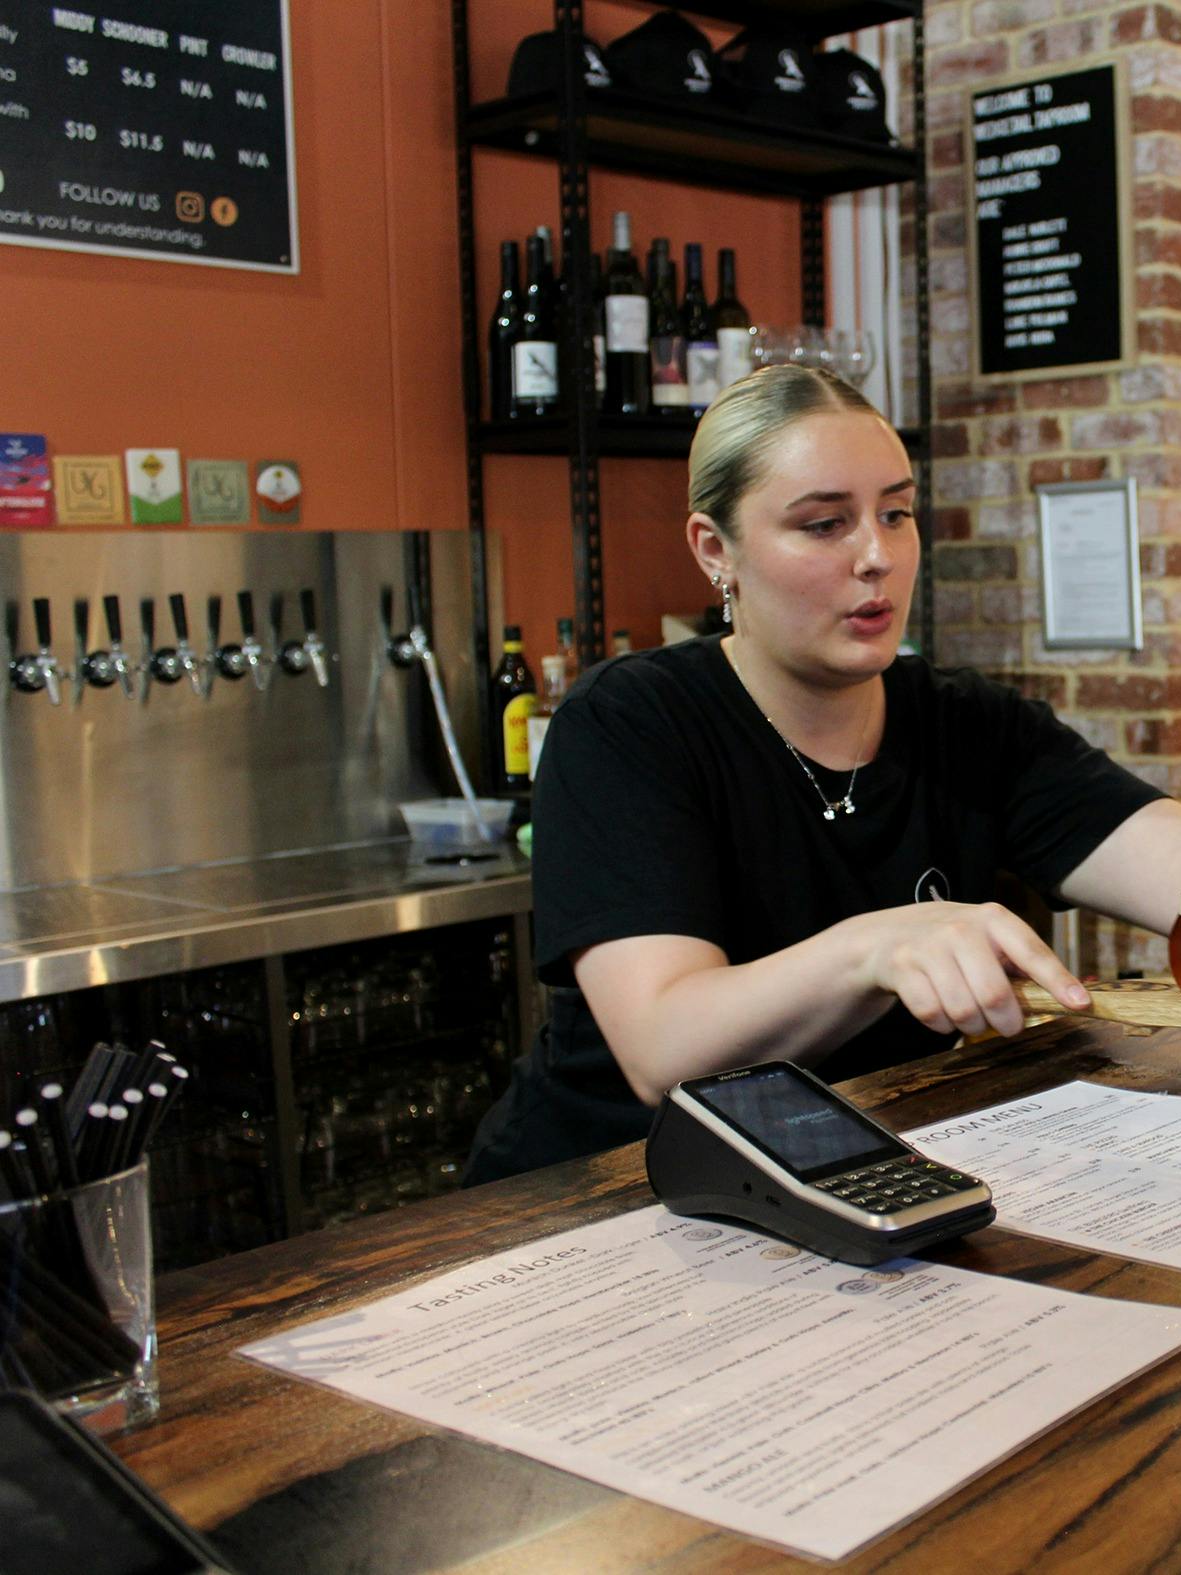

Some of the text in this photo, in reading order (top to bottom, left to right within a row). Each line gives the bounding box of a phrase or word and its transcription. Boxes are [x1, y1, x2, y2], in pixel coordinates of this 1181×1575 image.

[102, 19, 169, 48] SCHOONER
[179, 35, 208, 57] PINT
[66, 56, 88, 76] $5
[180, 79, 213, 99] N/A
[236, 89, 267, 109] N/A
[65, 120, 269, 168] $10 $11.5 N/A N/A
[59, 181, 161, 212] FOLLOW US
[37, 214, 68, 231] you
[70, 215, 92, 232] for
[718, 1070, 751, 1081] Verifone
[918, 1120, 984, 1145] ROOM
[980, 1103, 1042, 1126] MENU
[406, 1245, 588, 1313] Tasting Notes
[703, 1448, 787, 1493] MANGO ALE
